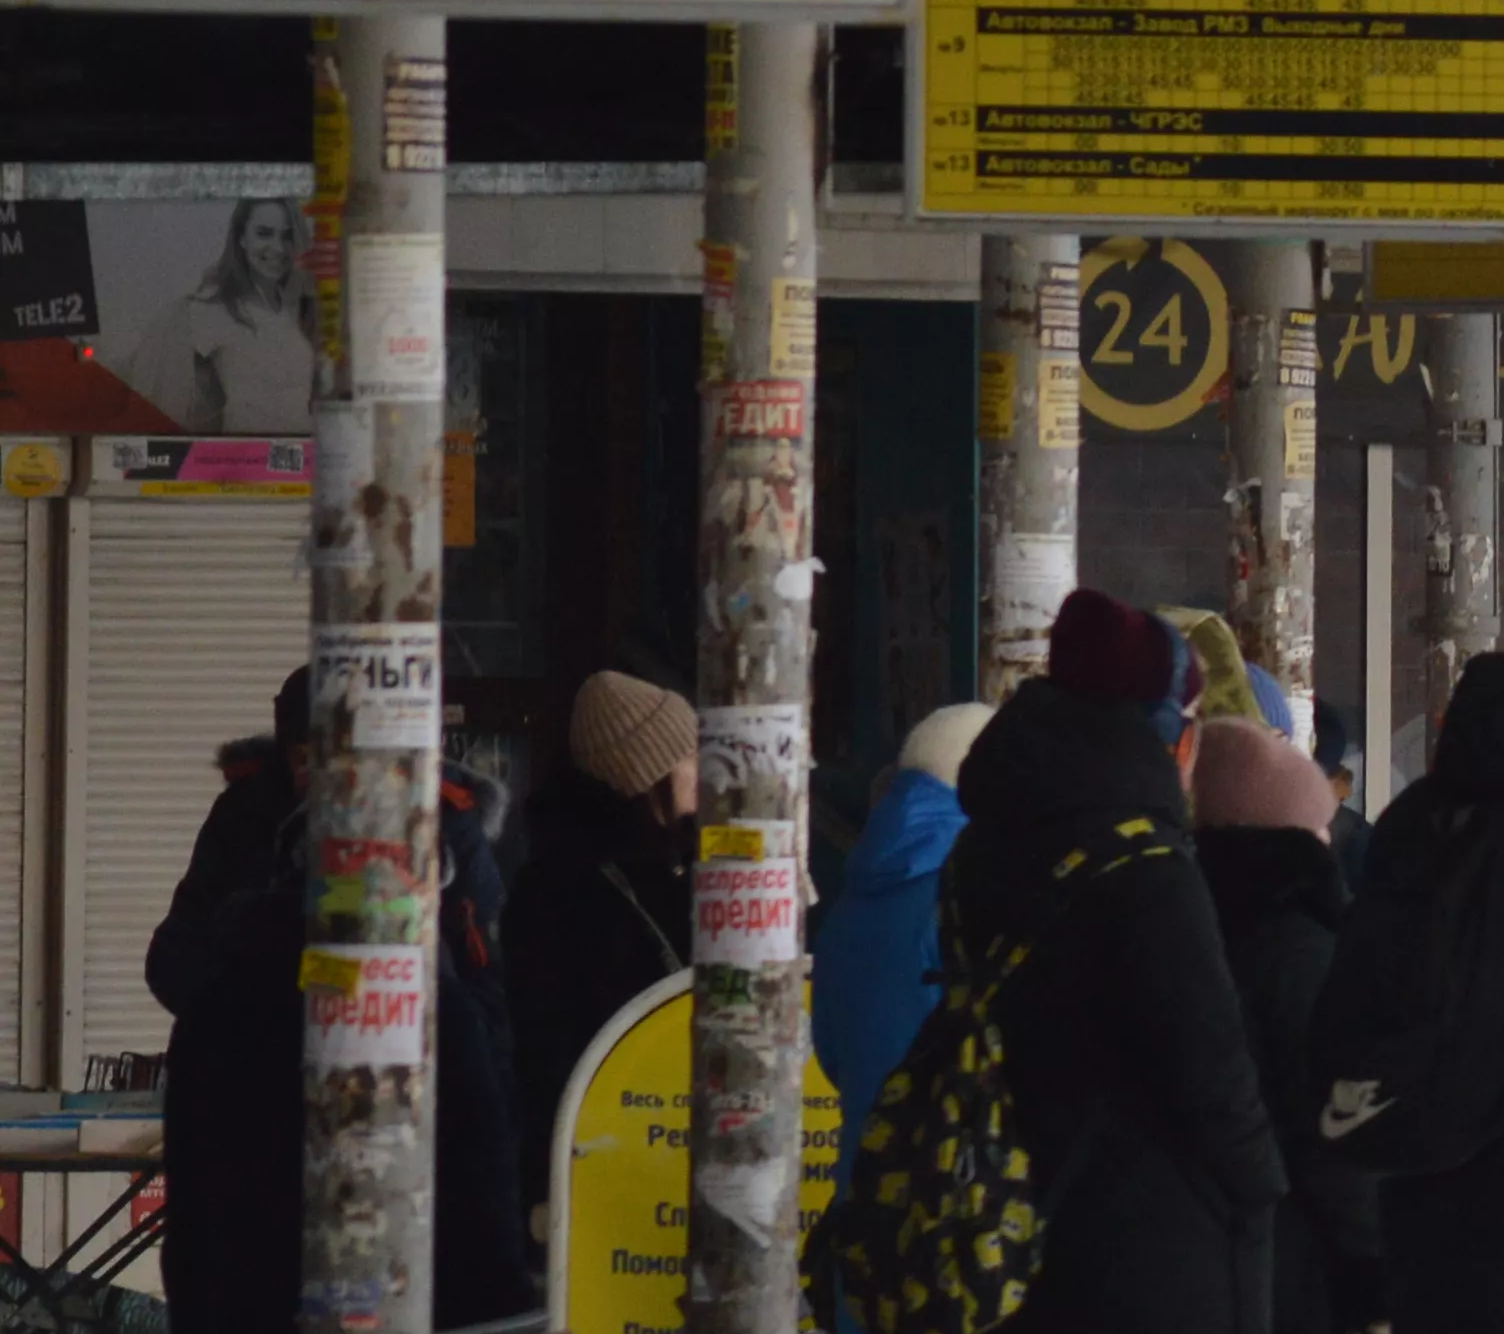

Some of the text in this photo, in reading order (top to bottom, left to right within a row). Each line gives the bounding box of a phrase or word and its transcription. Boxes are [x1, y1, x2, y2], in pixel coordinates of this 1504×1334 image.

[986, 11, 1114, 31] Автовокзал
[1133, 13, 1198, 33] Завод
[985, 109, 1113, 129] Автовокзал
[1128, 111, 1205, 131] ЧГРЭС
[985, 154, 1113, 174] Автовокзал
[13, 292, 85, 328] TELE2
[1090, 289, 1188, 366] 24
[722, 402, 801, 435] ЕДИТ
[698, 896, 792, 943] кредит
[620, 1090, 665, 1110] Весь
[672, 1093, 692, 1110] сп
[654, 1203, 688, 1232] Сп
